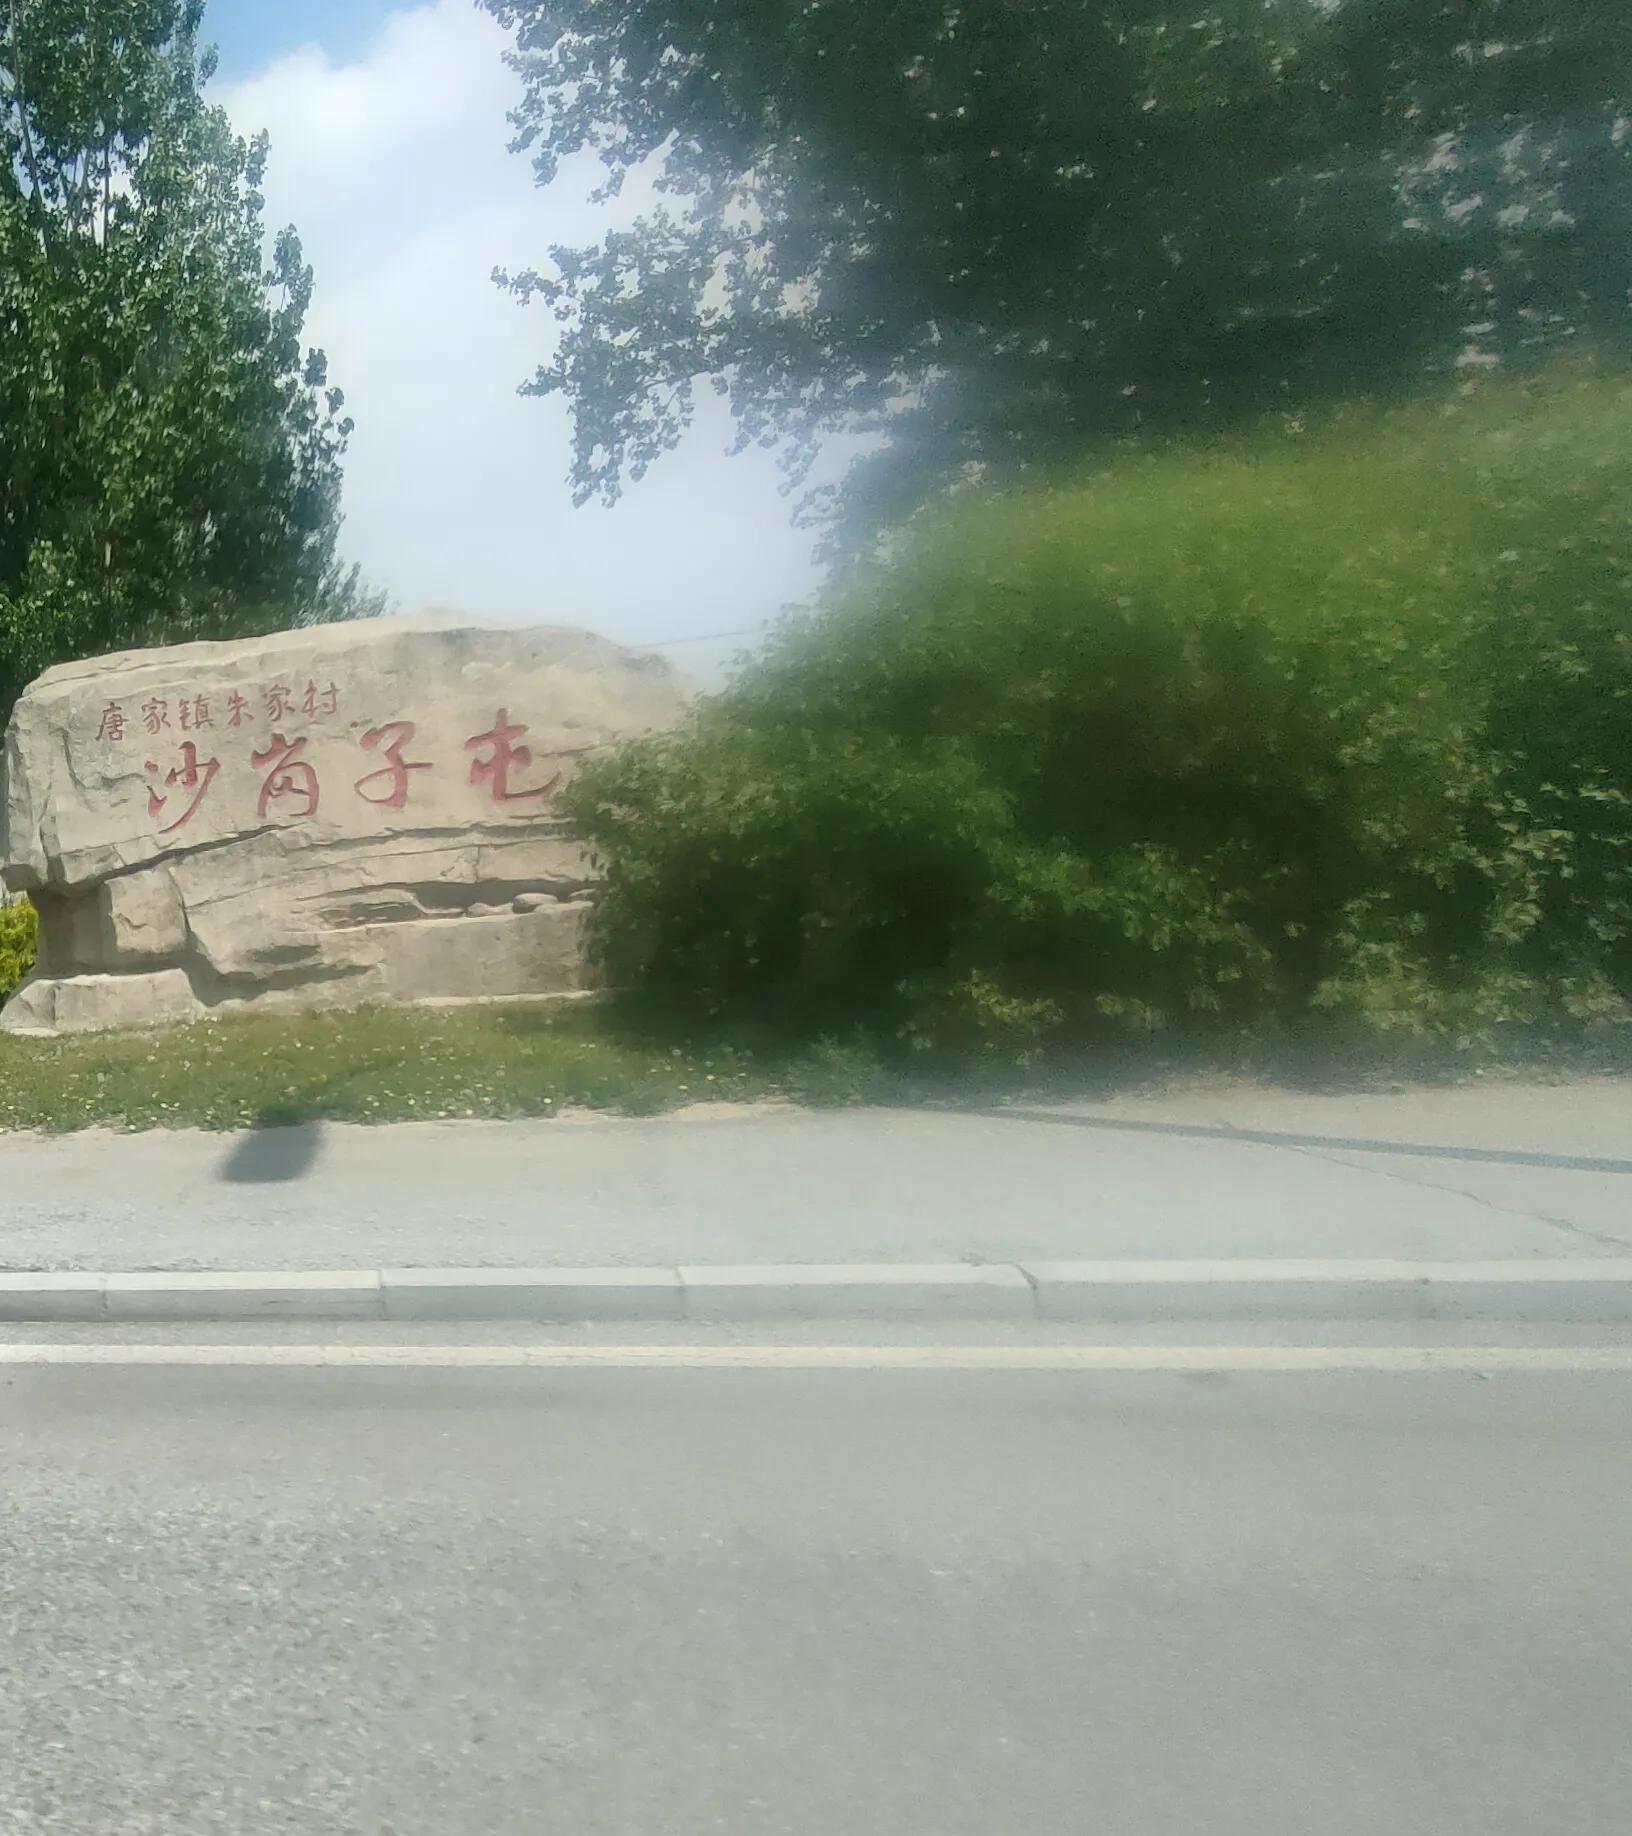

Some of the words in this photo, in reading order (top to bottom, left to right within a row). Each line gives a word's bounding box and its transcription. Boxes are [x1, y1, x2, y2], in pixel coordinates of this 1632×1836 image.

[95, 678, 342, 742] 唐家镇朱家村
[143, 706, 561, 835] 沙岗子屯
